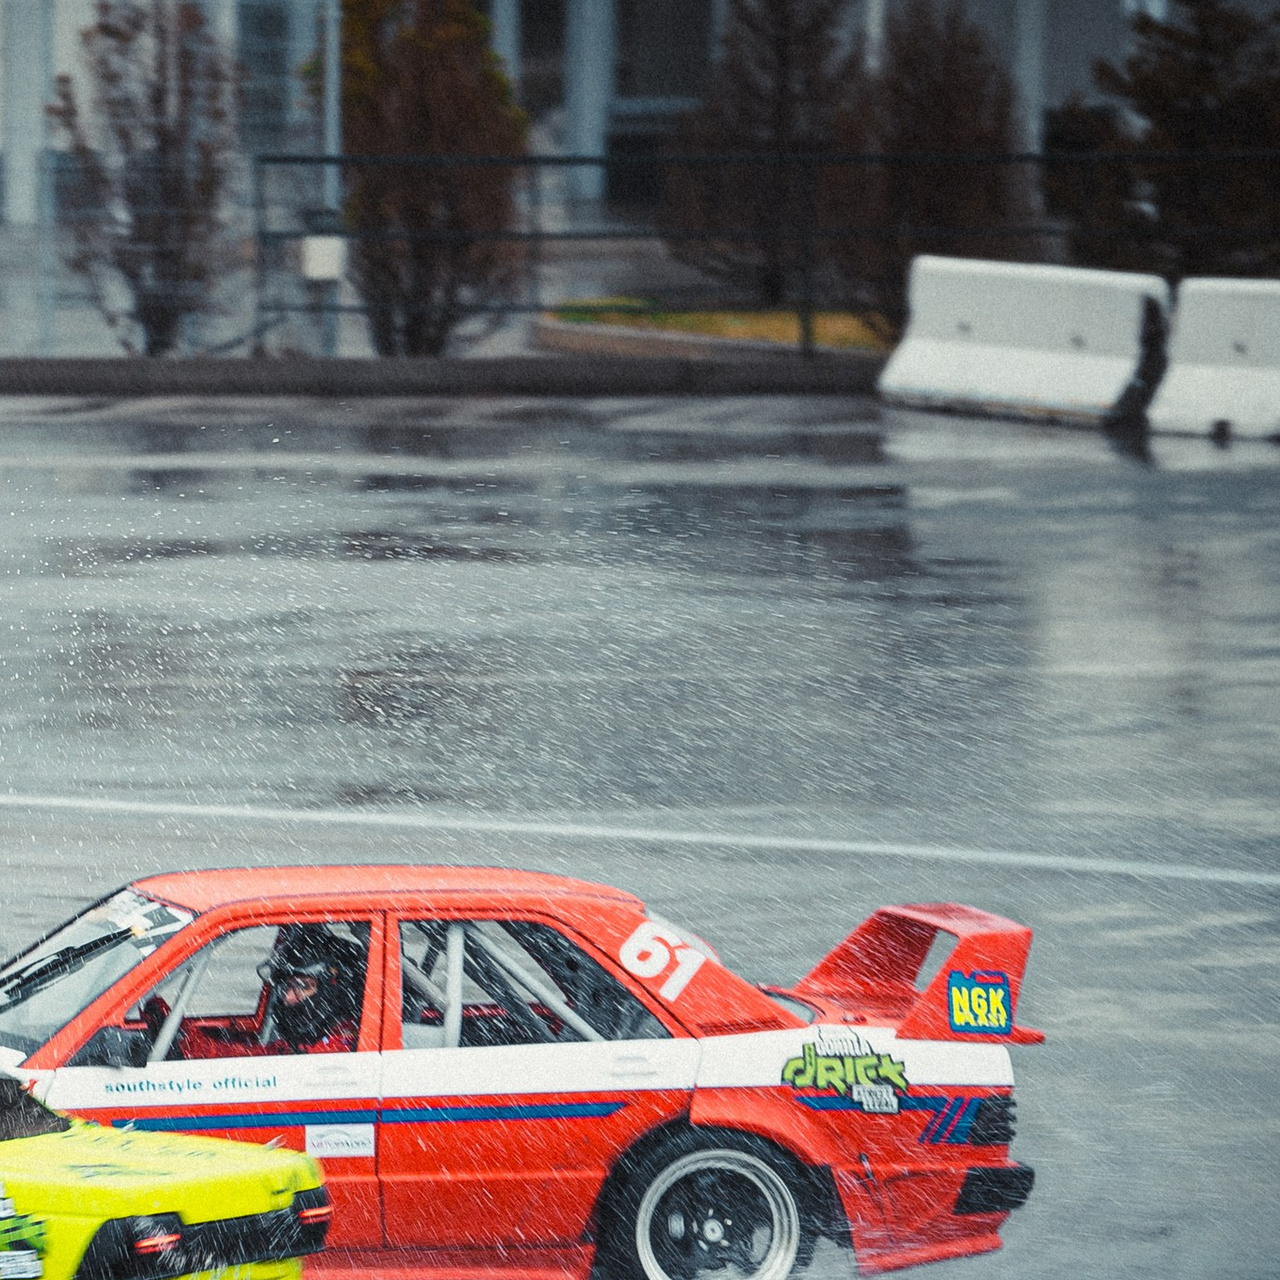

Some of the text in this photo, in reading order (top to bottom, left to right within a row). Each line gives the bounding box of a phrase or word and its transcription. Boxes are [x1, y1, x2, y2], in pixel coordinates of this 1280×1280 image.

[619, 920, 707, 1003] 61
[951, 986, 1008, 1020] NGK
[104, 1075, 278, 1093] southstyle official
